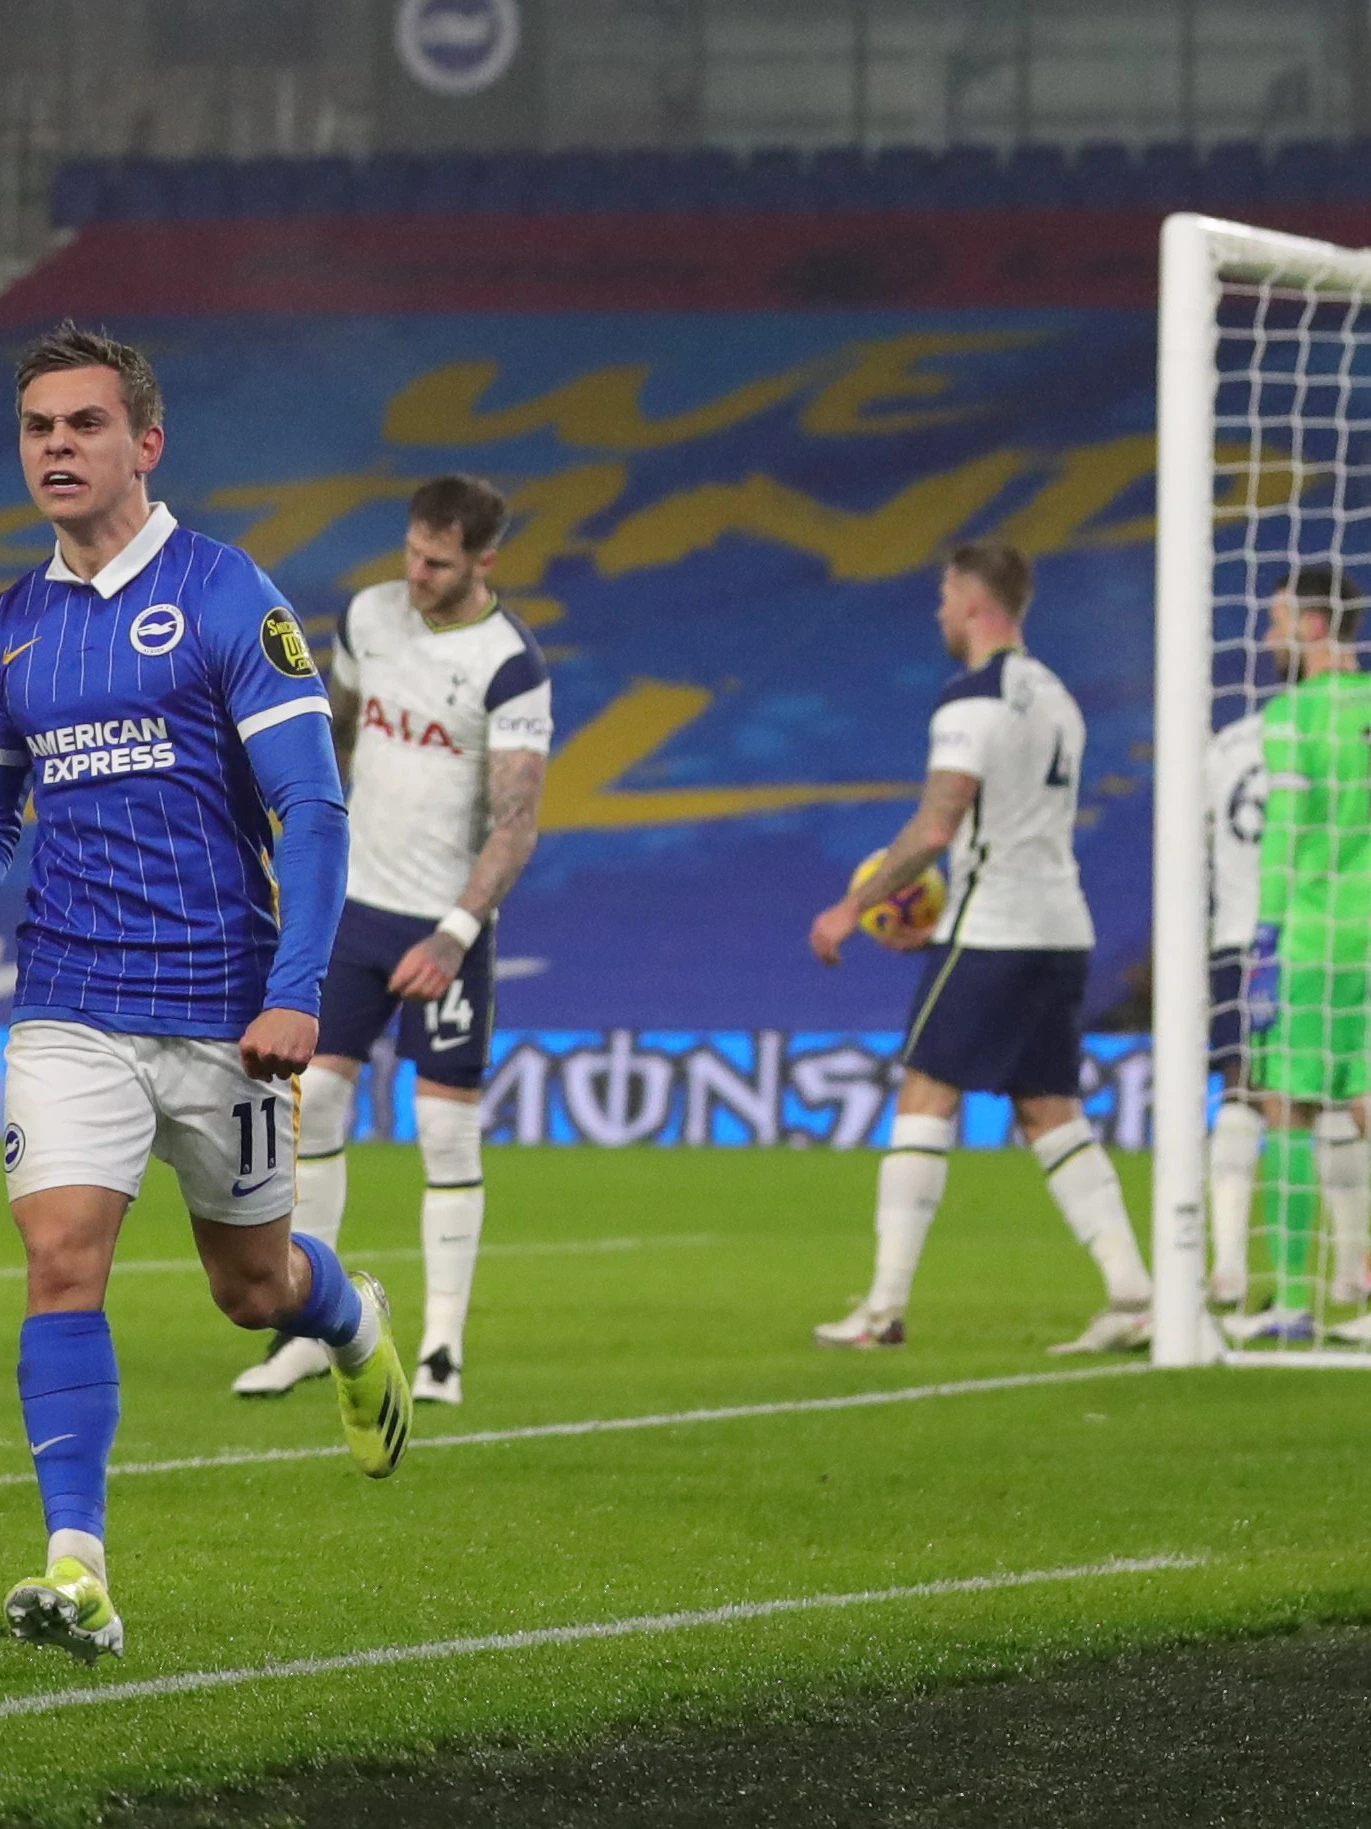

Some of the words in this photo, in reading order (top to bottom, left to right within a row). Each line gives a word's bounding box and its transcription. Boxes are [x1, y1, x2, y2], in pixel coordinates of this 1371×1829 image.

[25, 717, 168, 758] AMERICAN
[364, 697, 464, 756] AIA
[43, 742, 176, 785] EXPRESS
[1228, 765, 1265, 845] 6
[424, 979, 474, 1032] 14
[232, 1097, 276, 1175] 11
